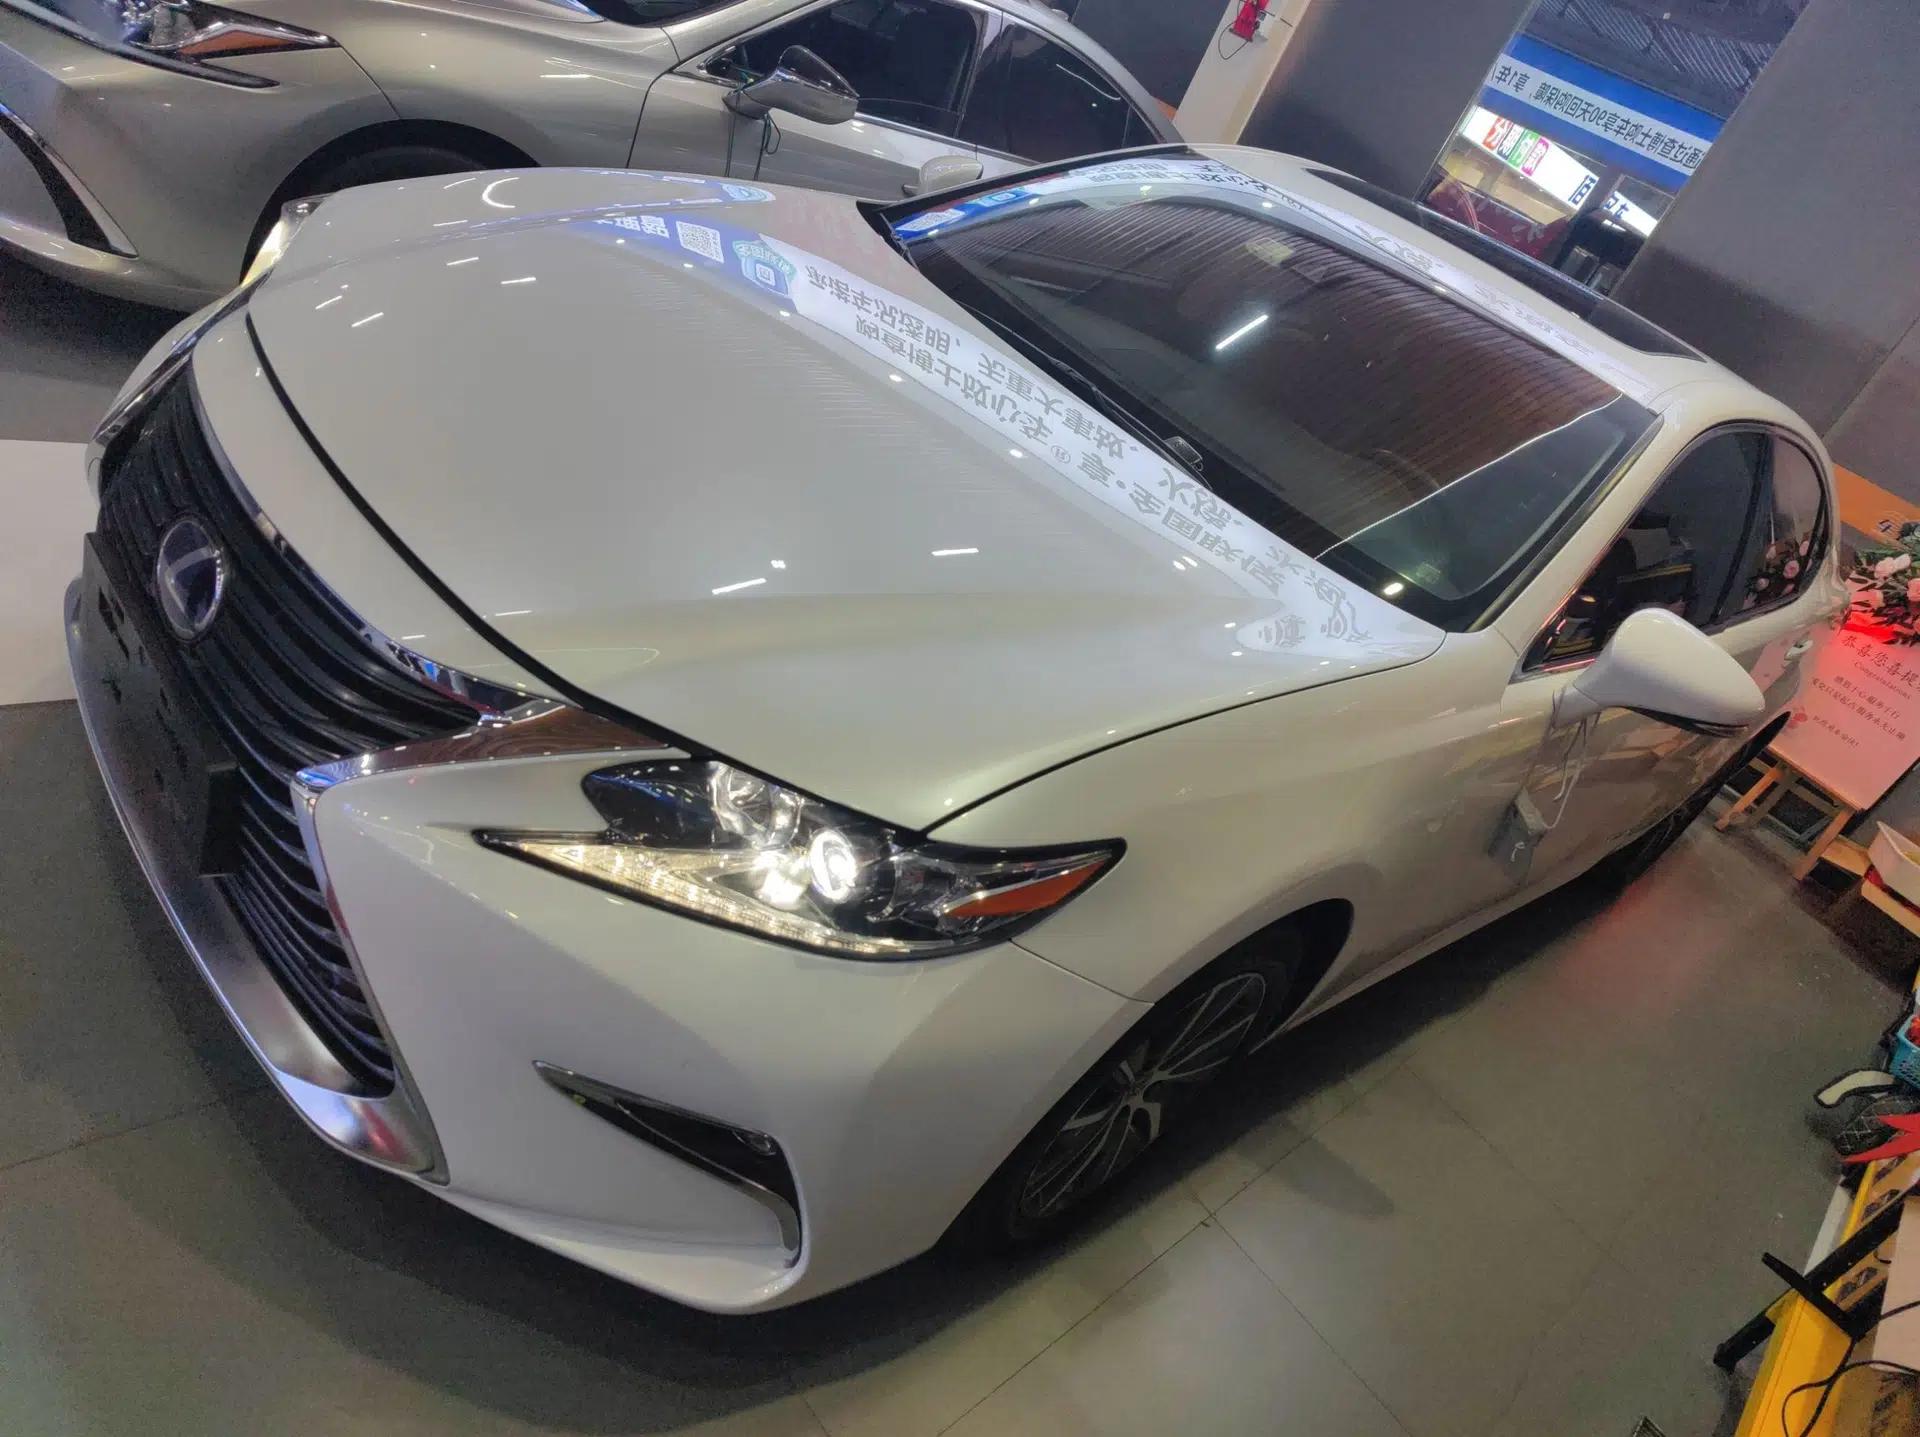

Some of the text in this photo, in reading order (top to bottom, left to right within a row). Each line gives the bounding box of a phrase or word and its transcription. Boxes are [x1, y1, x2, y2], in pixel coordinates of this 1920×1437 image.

[1841, 635, 1920, 693] 恭喜您喜提
